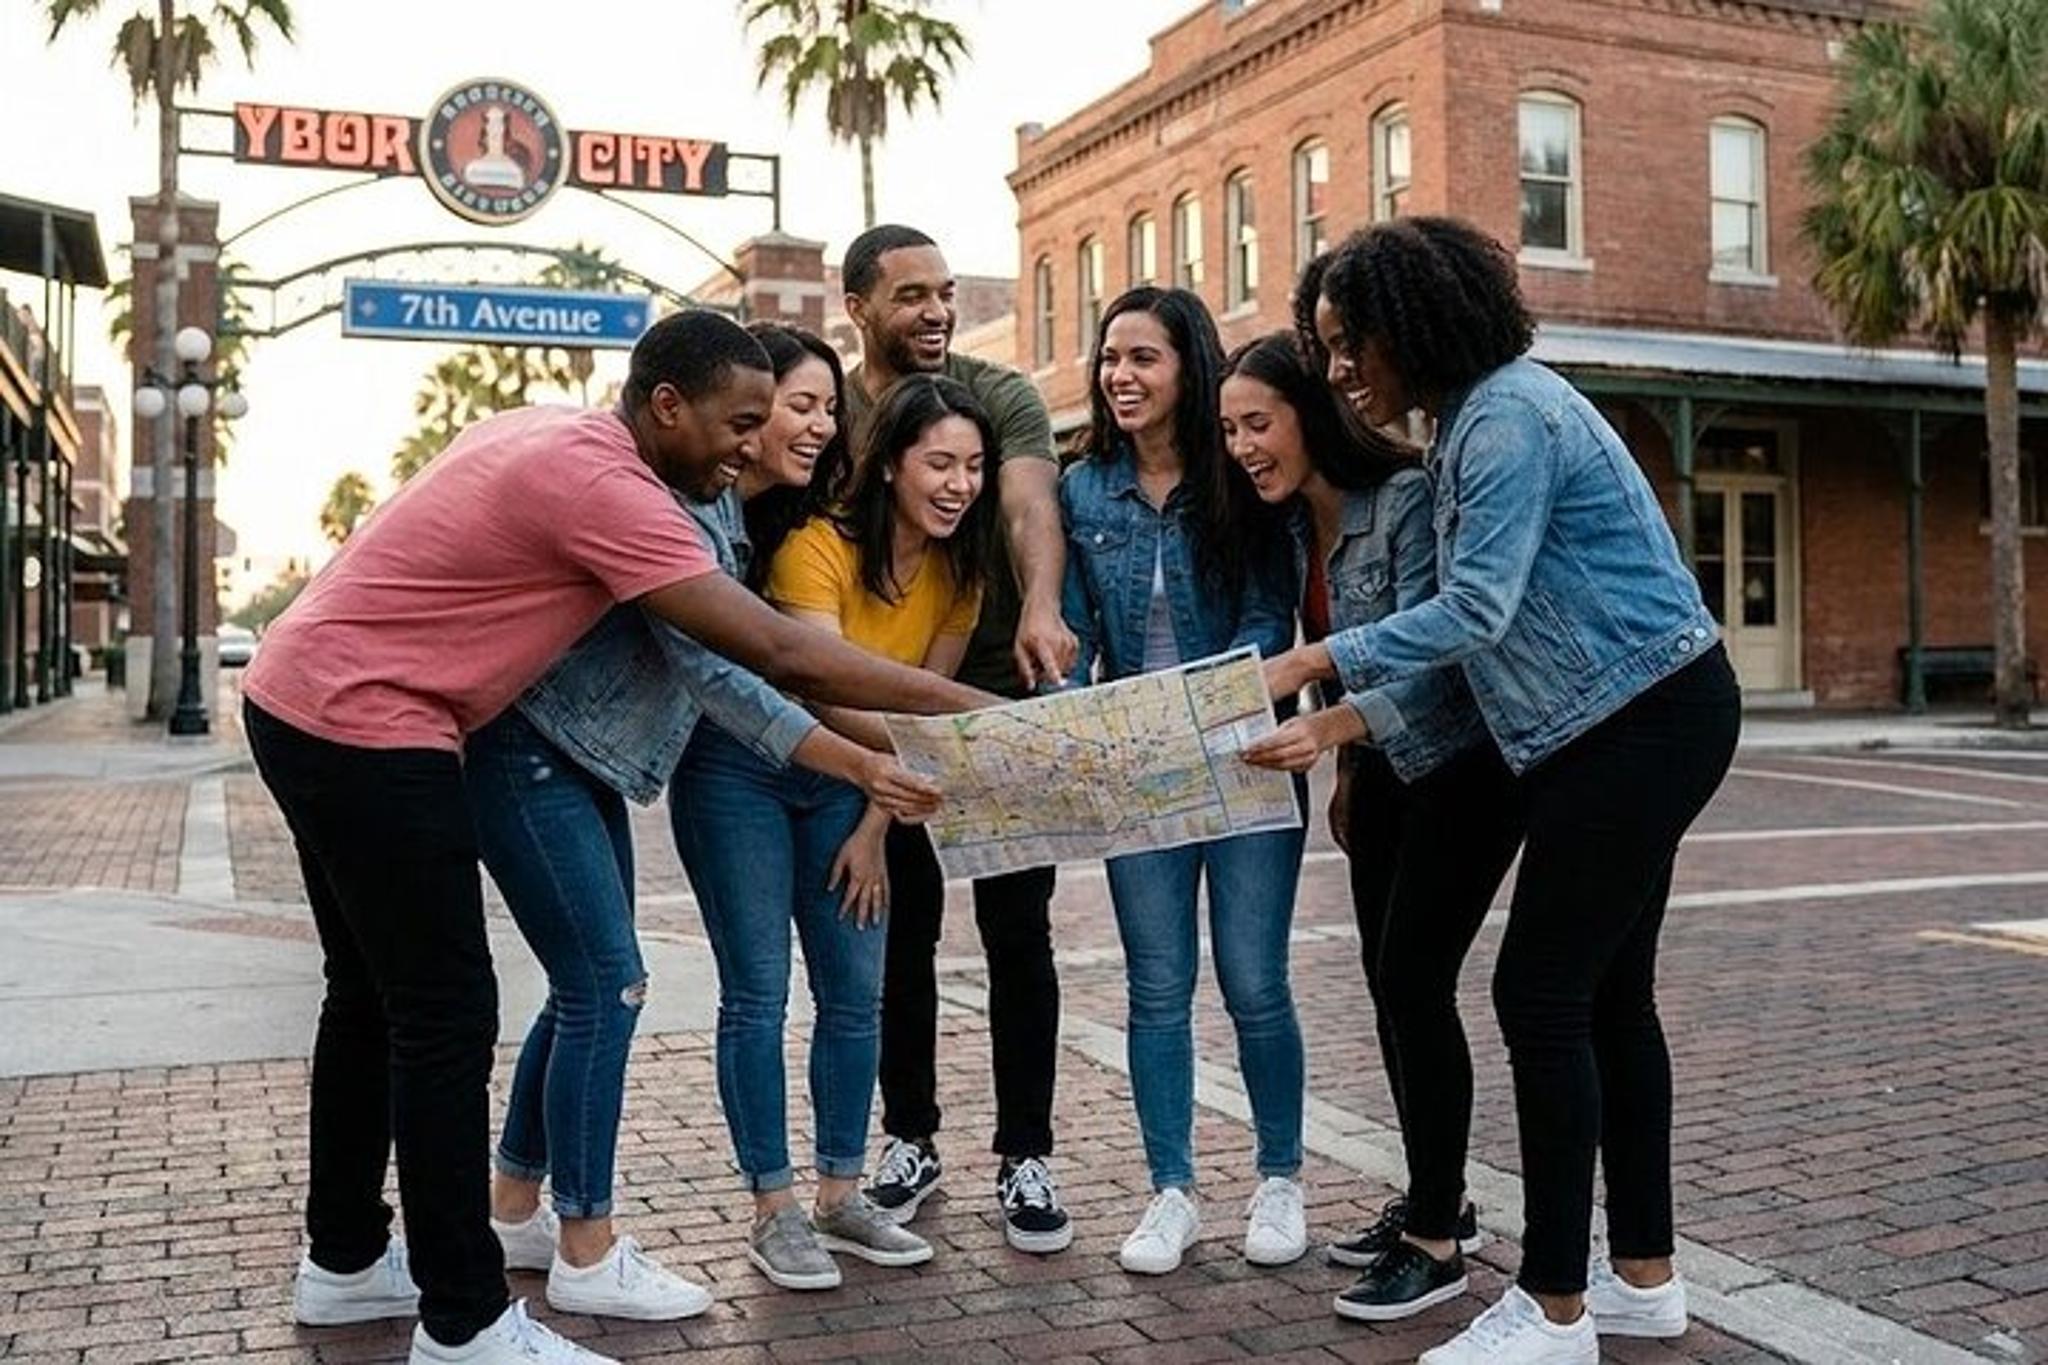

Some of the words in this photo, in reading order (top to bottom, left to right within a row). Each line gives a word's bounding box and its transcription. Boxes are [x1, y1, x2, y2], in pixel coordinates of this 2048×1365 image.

[237, 104, 416, 173] YBOR
[579, 133, 713, 189] CITY
[400, 294, 459, 326] 7th
[469, 298, 601, 333] Avenue
